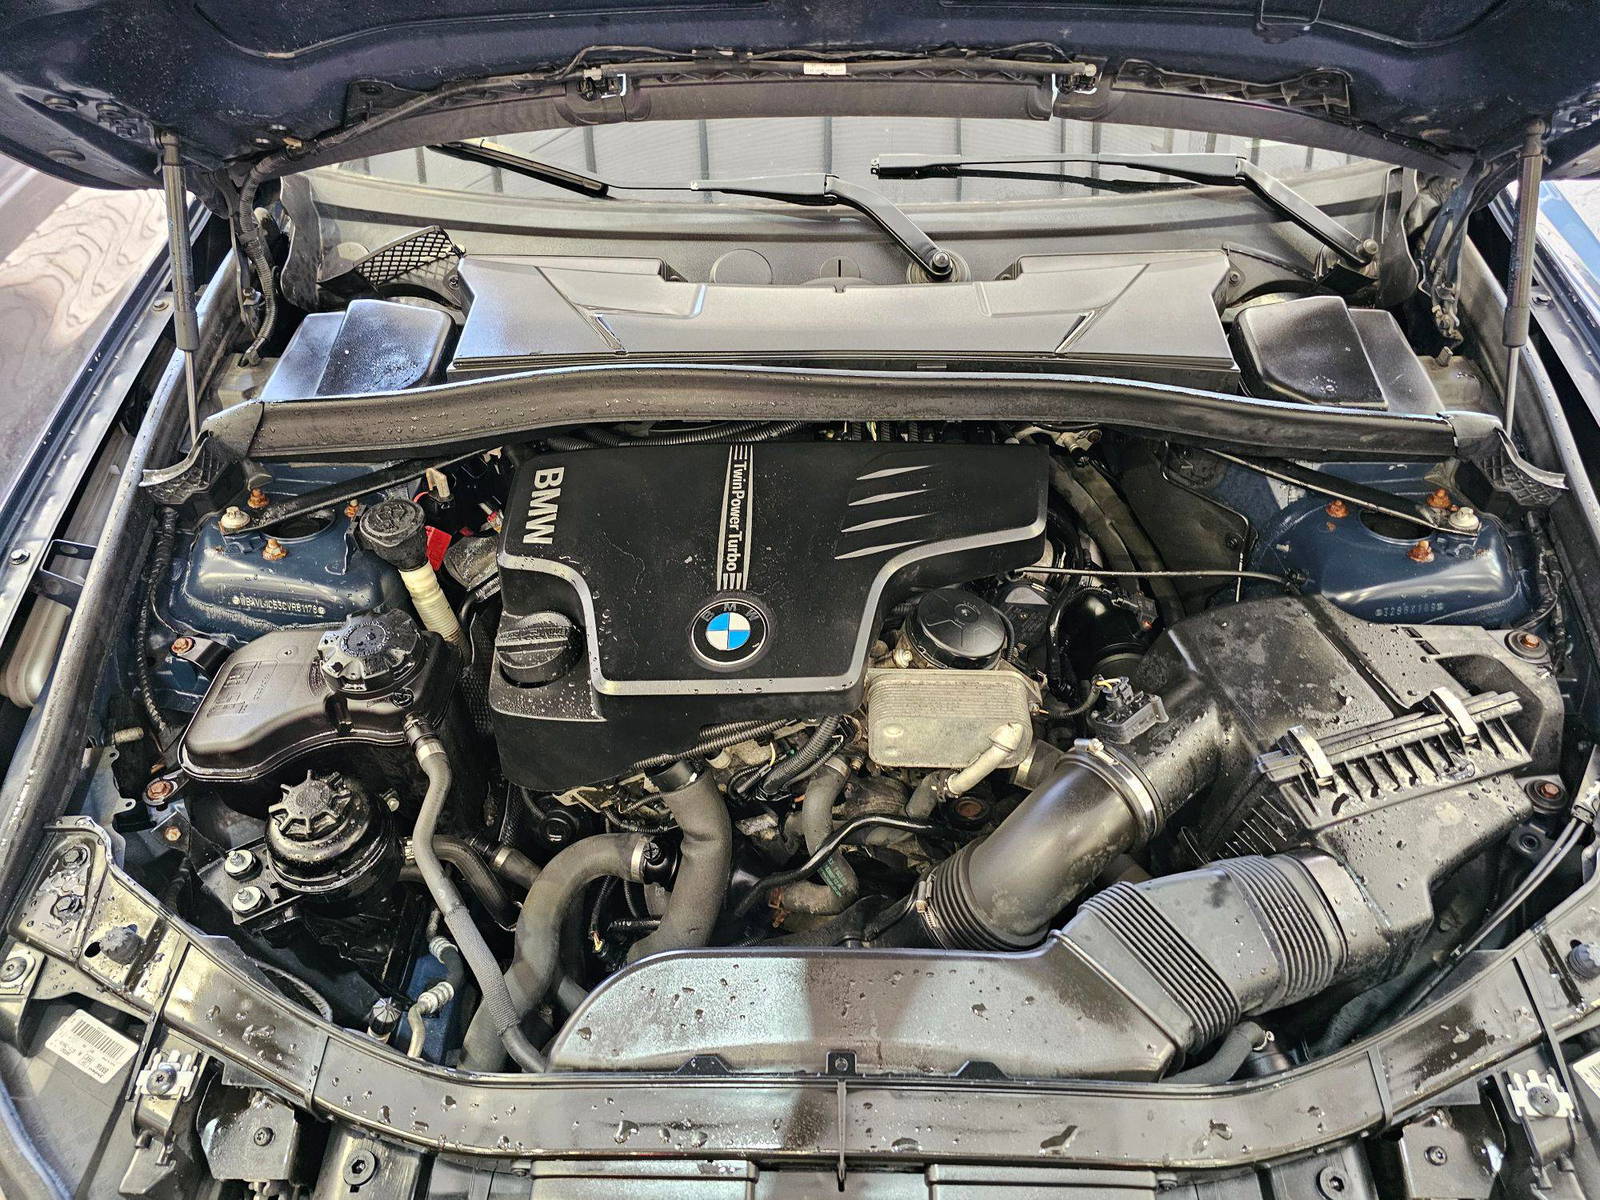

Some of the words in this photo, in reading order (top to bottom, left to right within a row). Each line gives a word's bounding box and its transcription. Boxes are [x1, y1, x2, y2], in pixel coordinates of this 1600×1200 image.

[523, 467, 565, 544] BMW
[726, 531, 743, 572] Turbo
[701, 603, 760, 621] BMW
